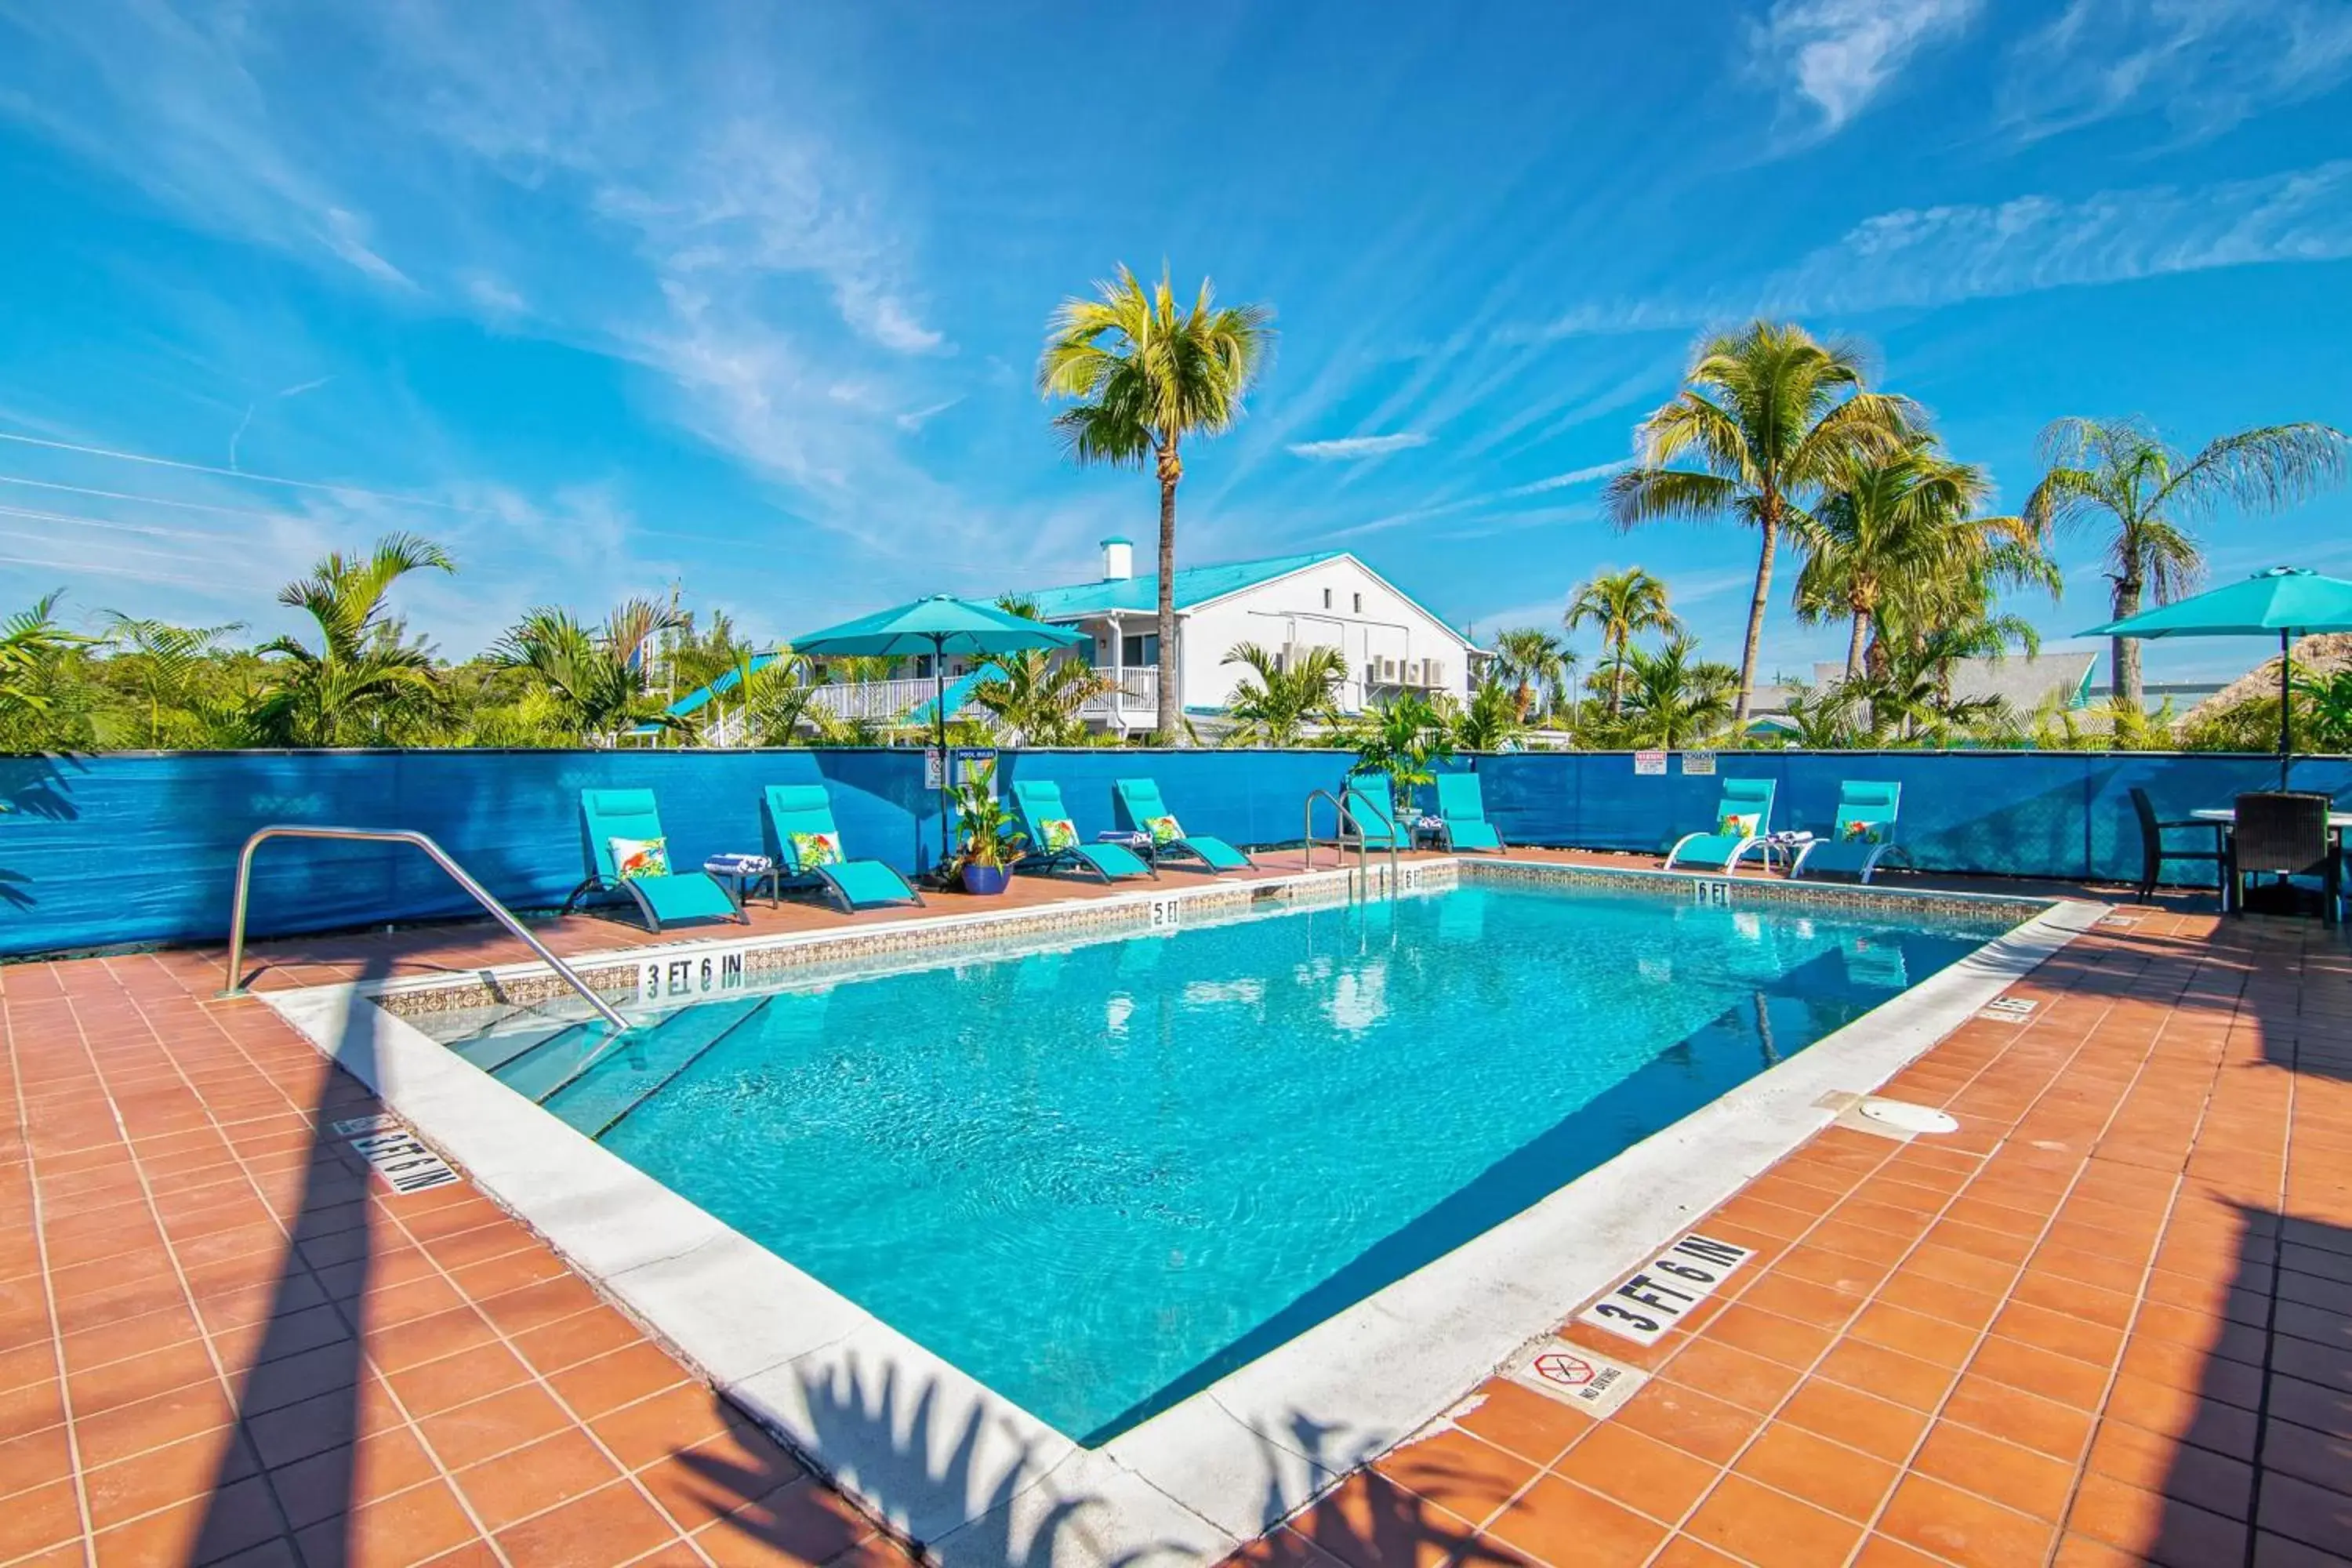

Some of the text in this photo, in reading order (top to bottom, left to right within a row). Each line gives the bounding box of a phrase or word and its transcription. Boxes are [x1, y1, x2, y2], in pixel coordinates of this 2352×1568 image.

[1699, 882, 1707, 896] 6
[1154, 901, 1178, 916] 5 FT
[648, 953, 741, 983] 3 FT 6 IN
[358, 1134, 458, 1191] 3 FT 6 IN
[1595, 1236, 1745, 1331] 3 FT 6 IN
[1580, 1367, 1622, 1400] NO DIVING
